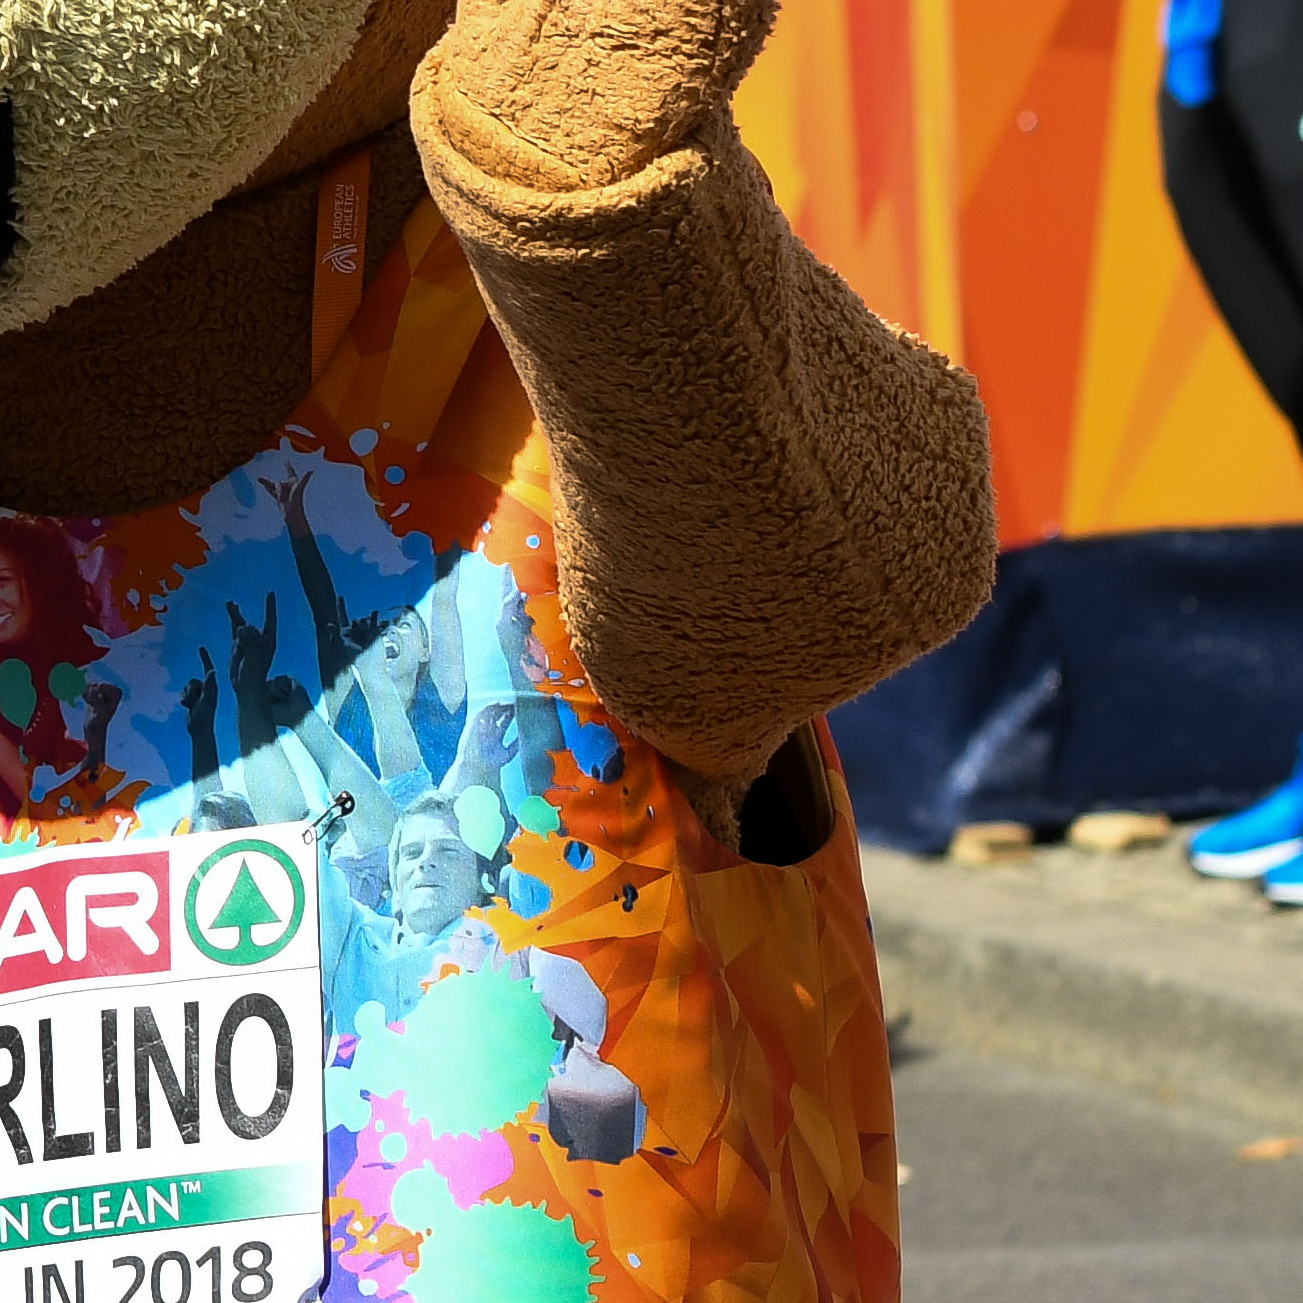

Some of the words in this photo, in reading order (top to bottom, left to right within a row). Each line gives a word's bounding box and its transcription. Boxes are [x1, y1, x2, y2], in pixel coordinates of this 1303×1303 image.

[333, 184, 345, 239] EUROPEAN
[343, 184, 355, 239] ATHLETICS
[111, 1240, 274, 1303] 2018
